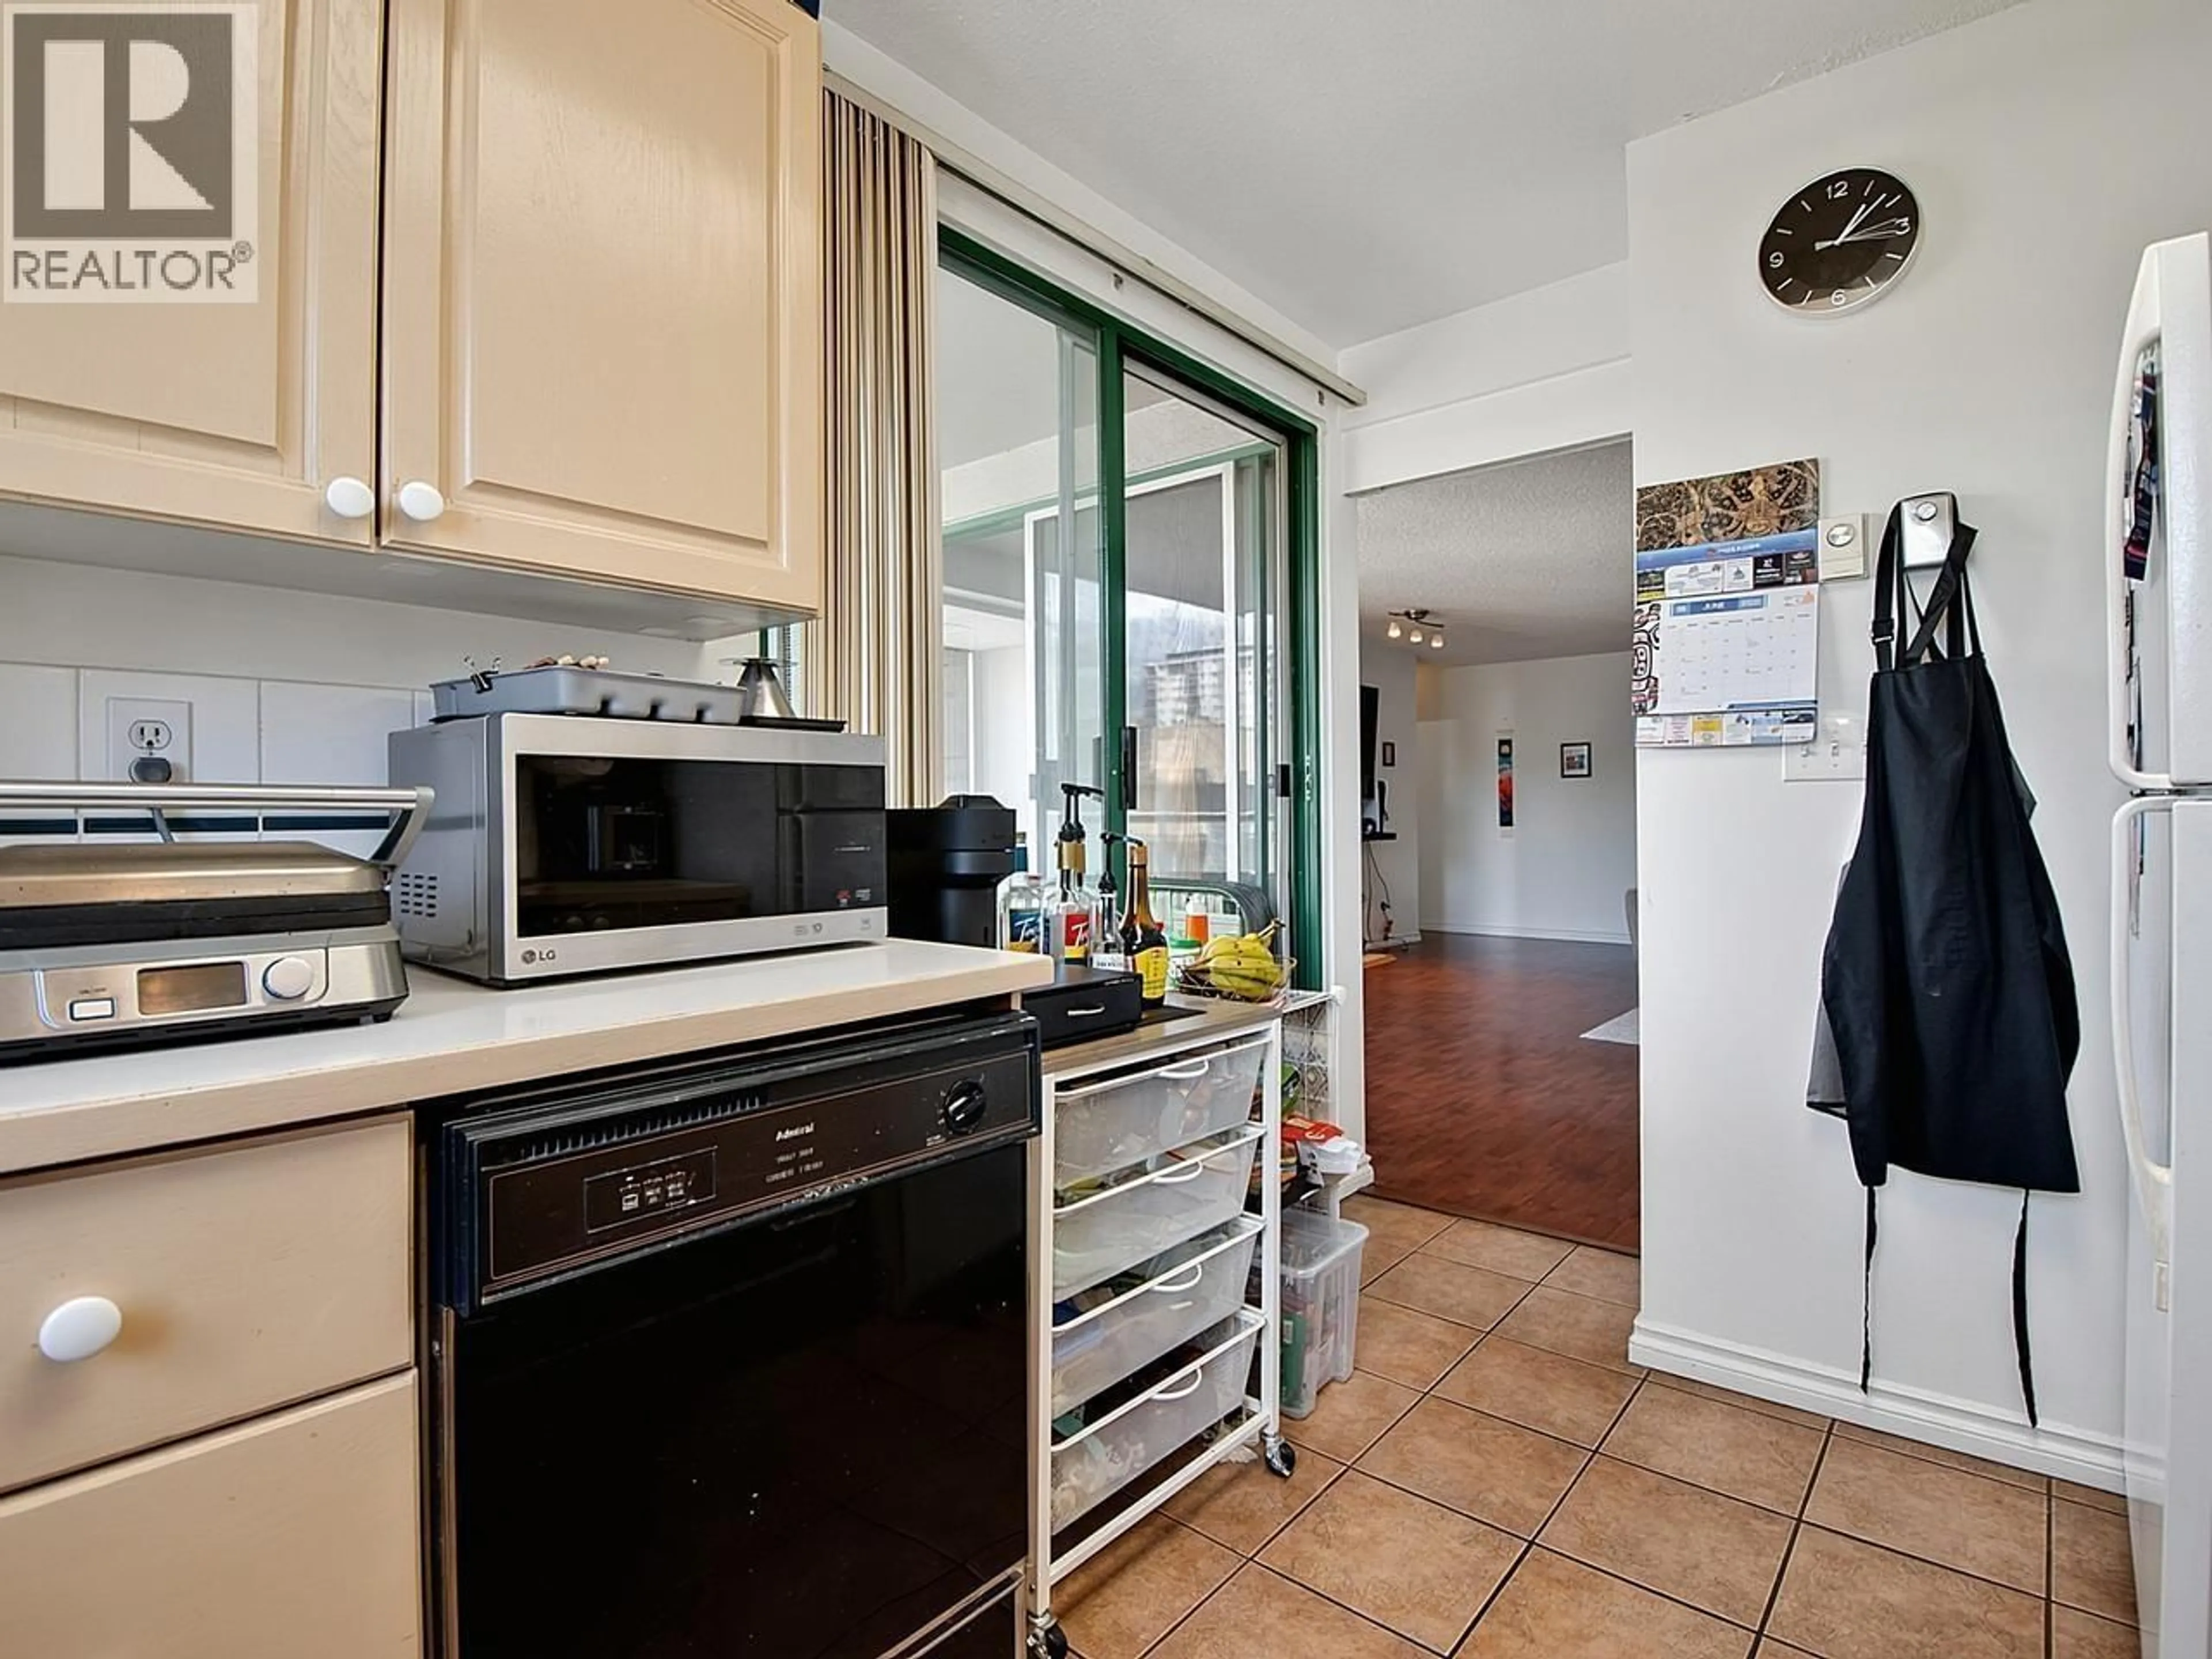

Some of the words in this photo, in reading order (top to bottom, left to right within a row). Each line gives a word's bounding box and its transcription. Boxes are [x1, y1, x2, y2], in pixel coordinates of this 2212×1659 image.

[1827, 181, 1849, 200] 12
[1895, 217, 1911, 234] 3
[1770, 252, 1785, 268] 9
[1831, 289, 1846, 305] 6
[539, 949, 556, 961] LG
